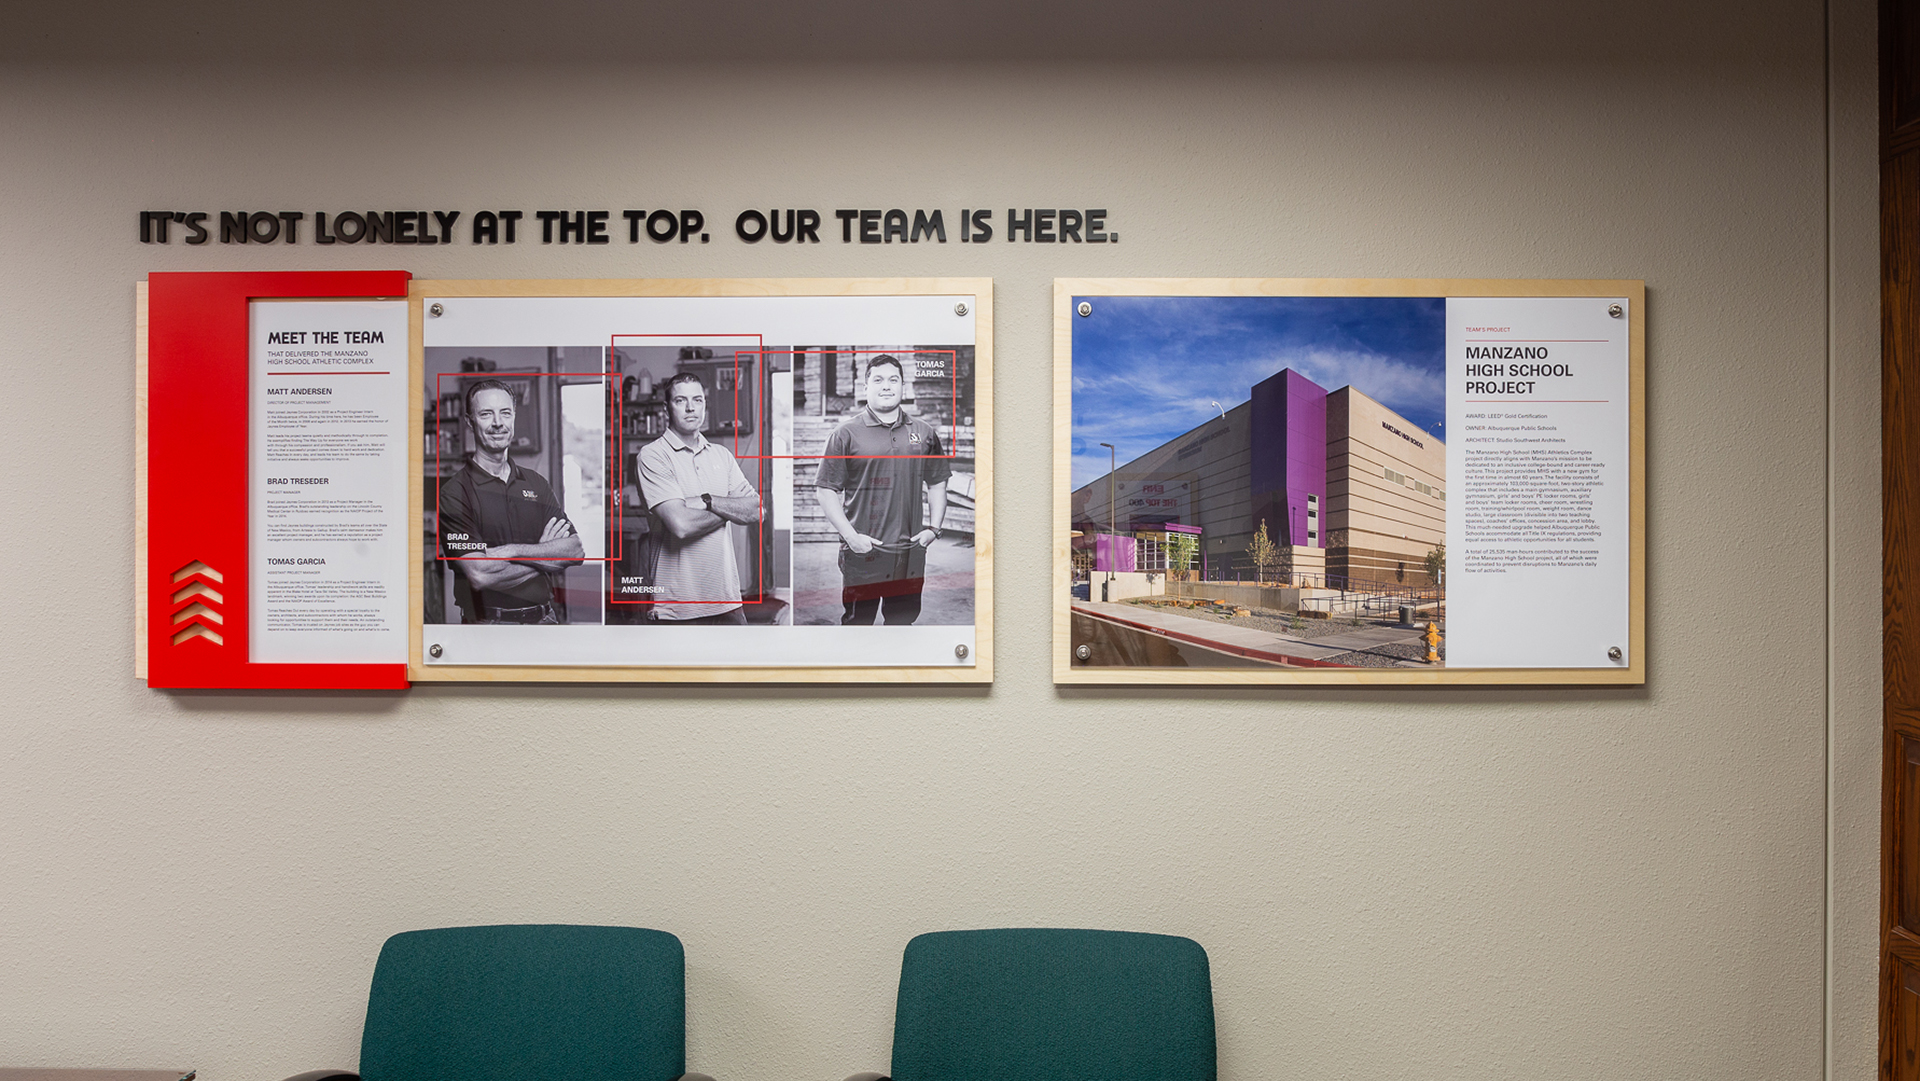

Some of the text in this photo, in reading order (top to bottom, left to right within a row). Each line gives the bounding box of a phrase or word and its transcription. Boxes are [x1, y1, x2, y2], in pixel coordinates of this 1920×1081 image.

[140, 208, 1118, 244] IT'S NOT LONELY AT THE TOP. OUR TEAM IS HERE.
[268, 331, 384, 345] MEET THE TEAM
[1466, 347, 1548, 360] MANZANO
[1466, 364, 1574, 377] HIGH SCHOOL
[290, 387, 332, 395] ANDERSEN
[1466, 381, 1536, 394] PROJECT
[1410, 437, 1424, 450] SCHOOL
[268, 557, 326, 566] TOMAS GARCIA
